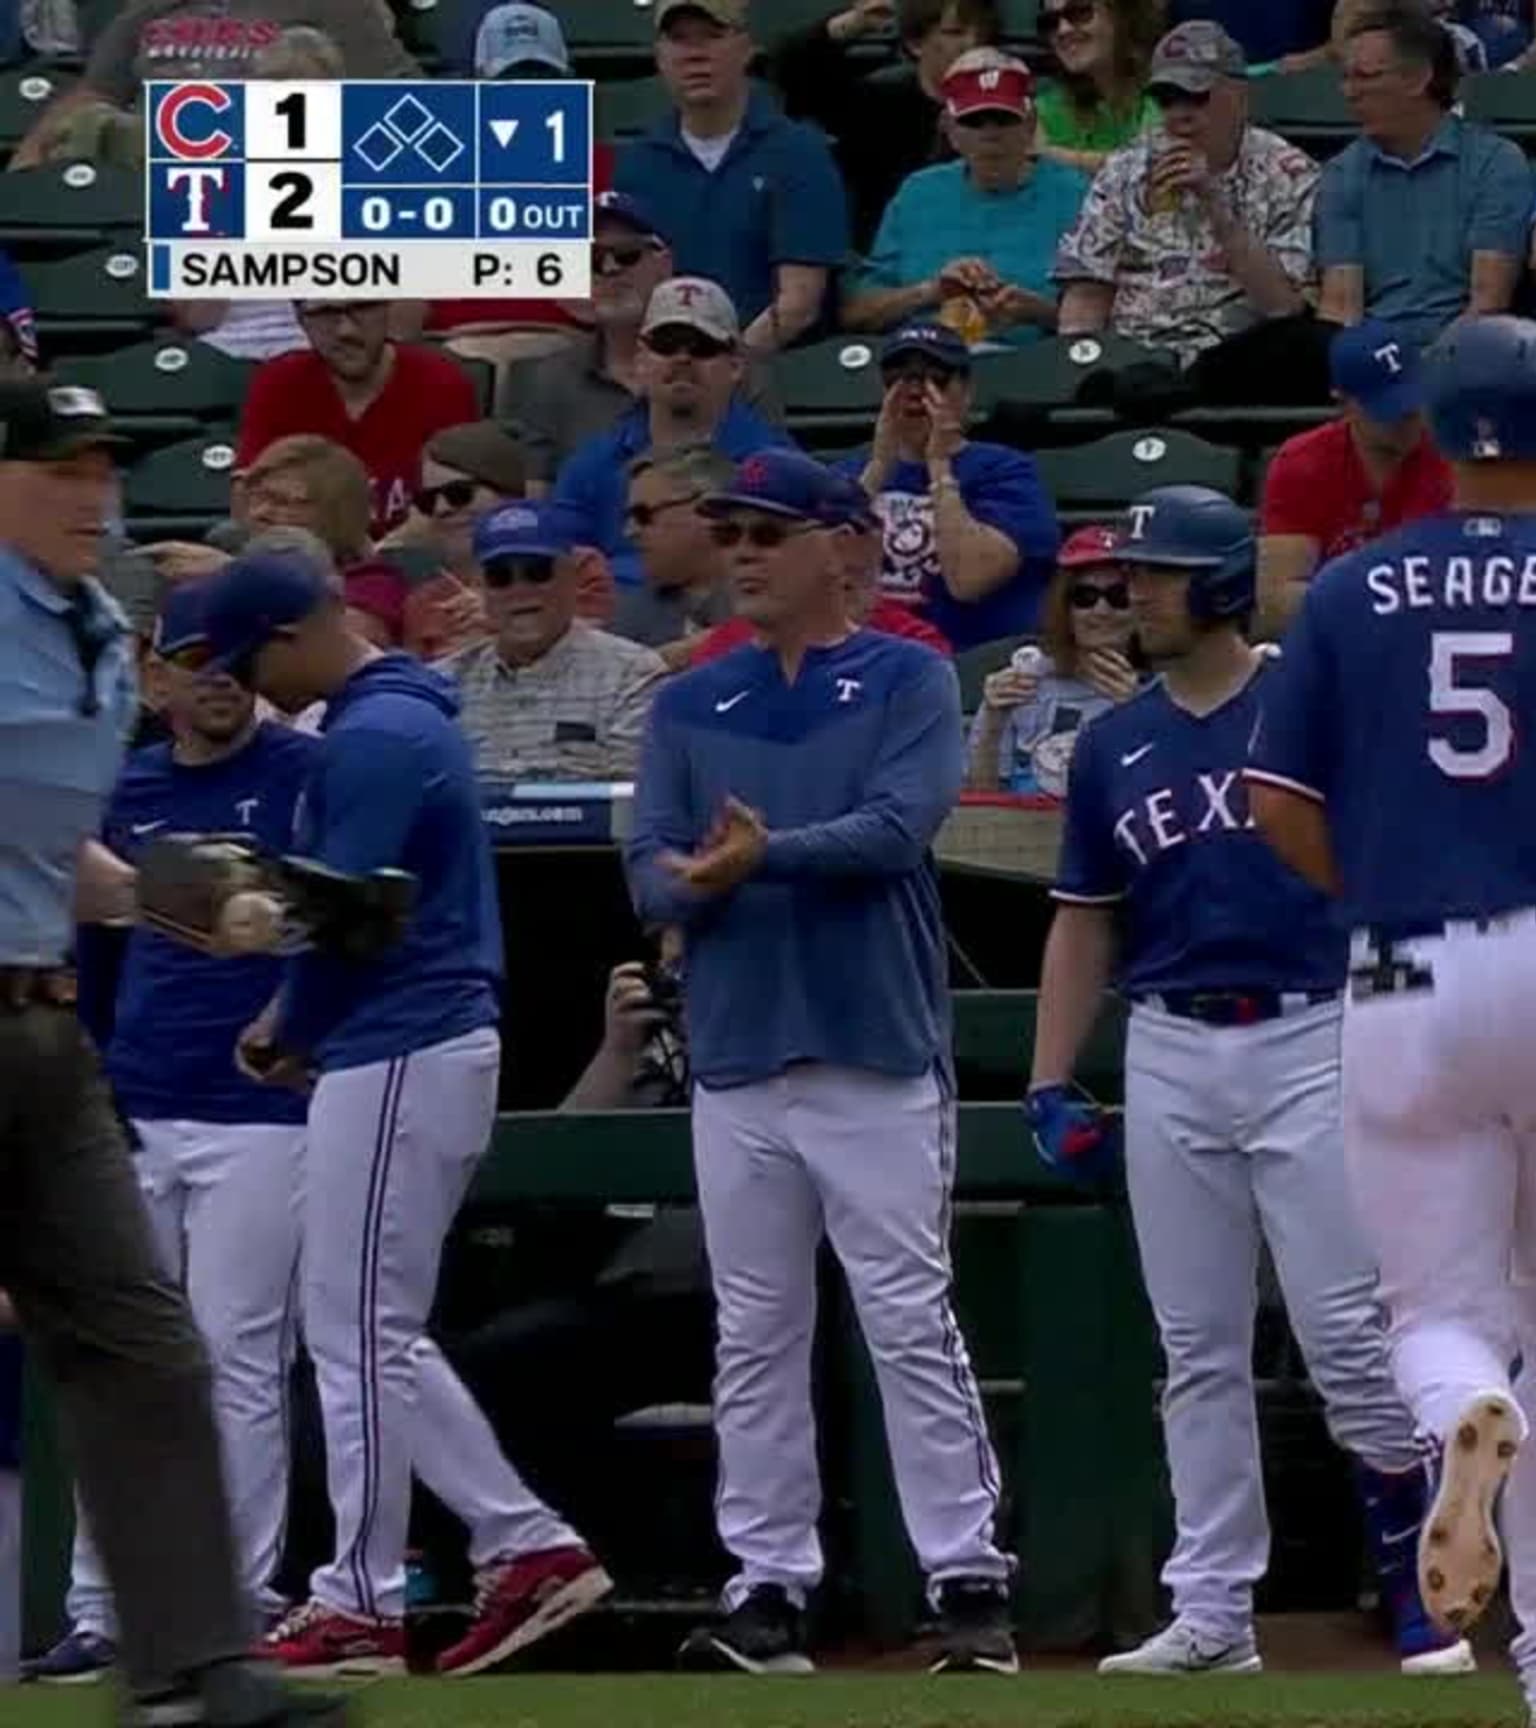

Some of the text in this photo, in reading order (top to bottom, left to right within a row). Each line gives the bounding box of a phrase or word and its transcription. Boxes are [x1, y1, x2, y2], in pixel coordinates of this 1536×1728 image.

[1374, 342, 1402, 374] T
[1129, 505, 1155, 539] T
[836, 678, 862, 702] T
[1427, 631, 1516, 780] 5
[234, 798, 259, 827] T
[1113, 770, 1256, 866] TEX
